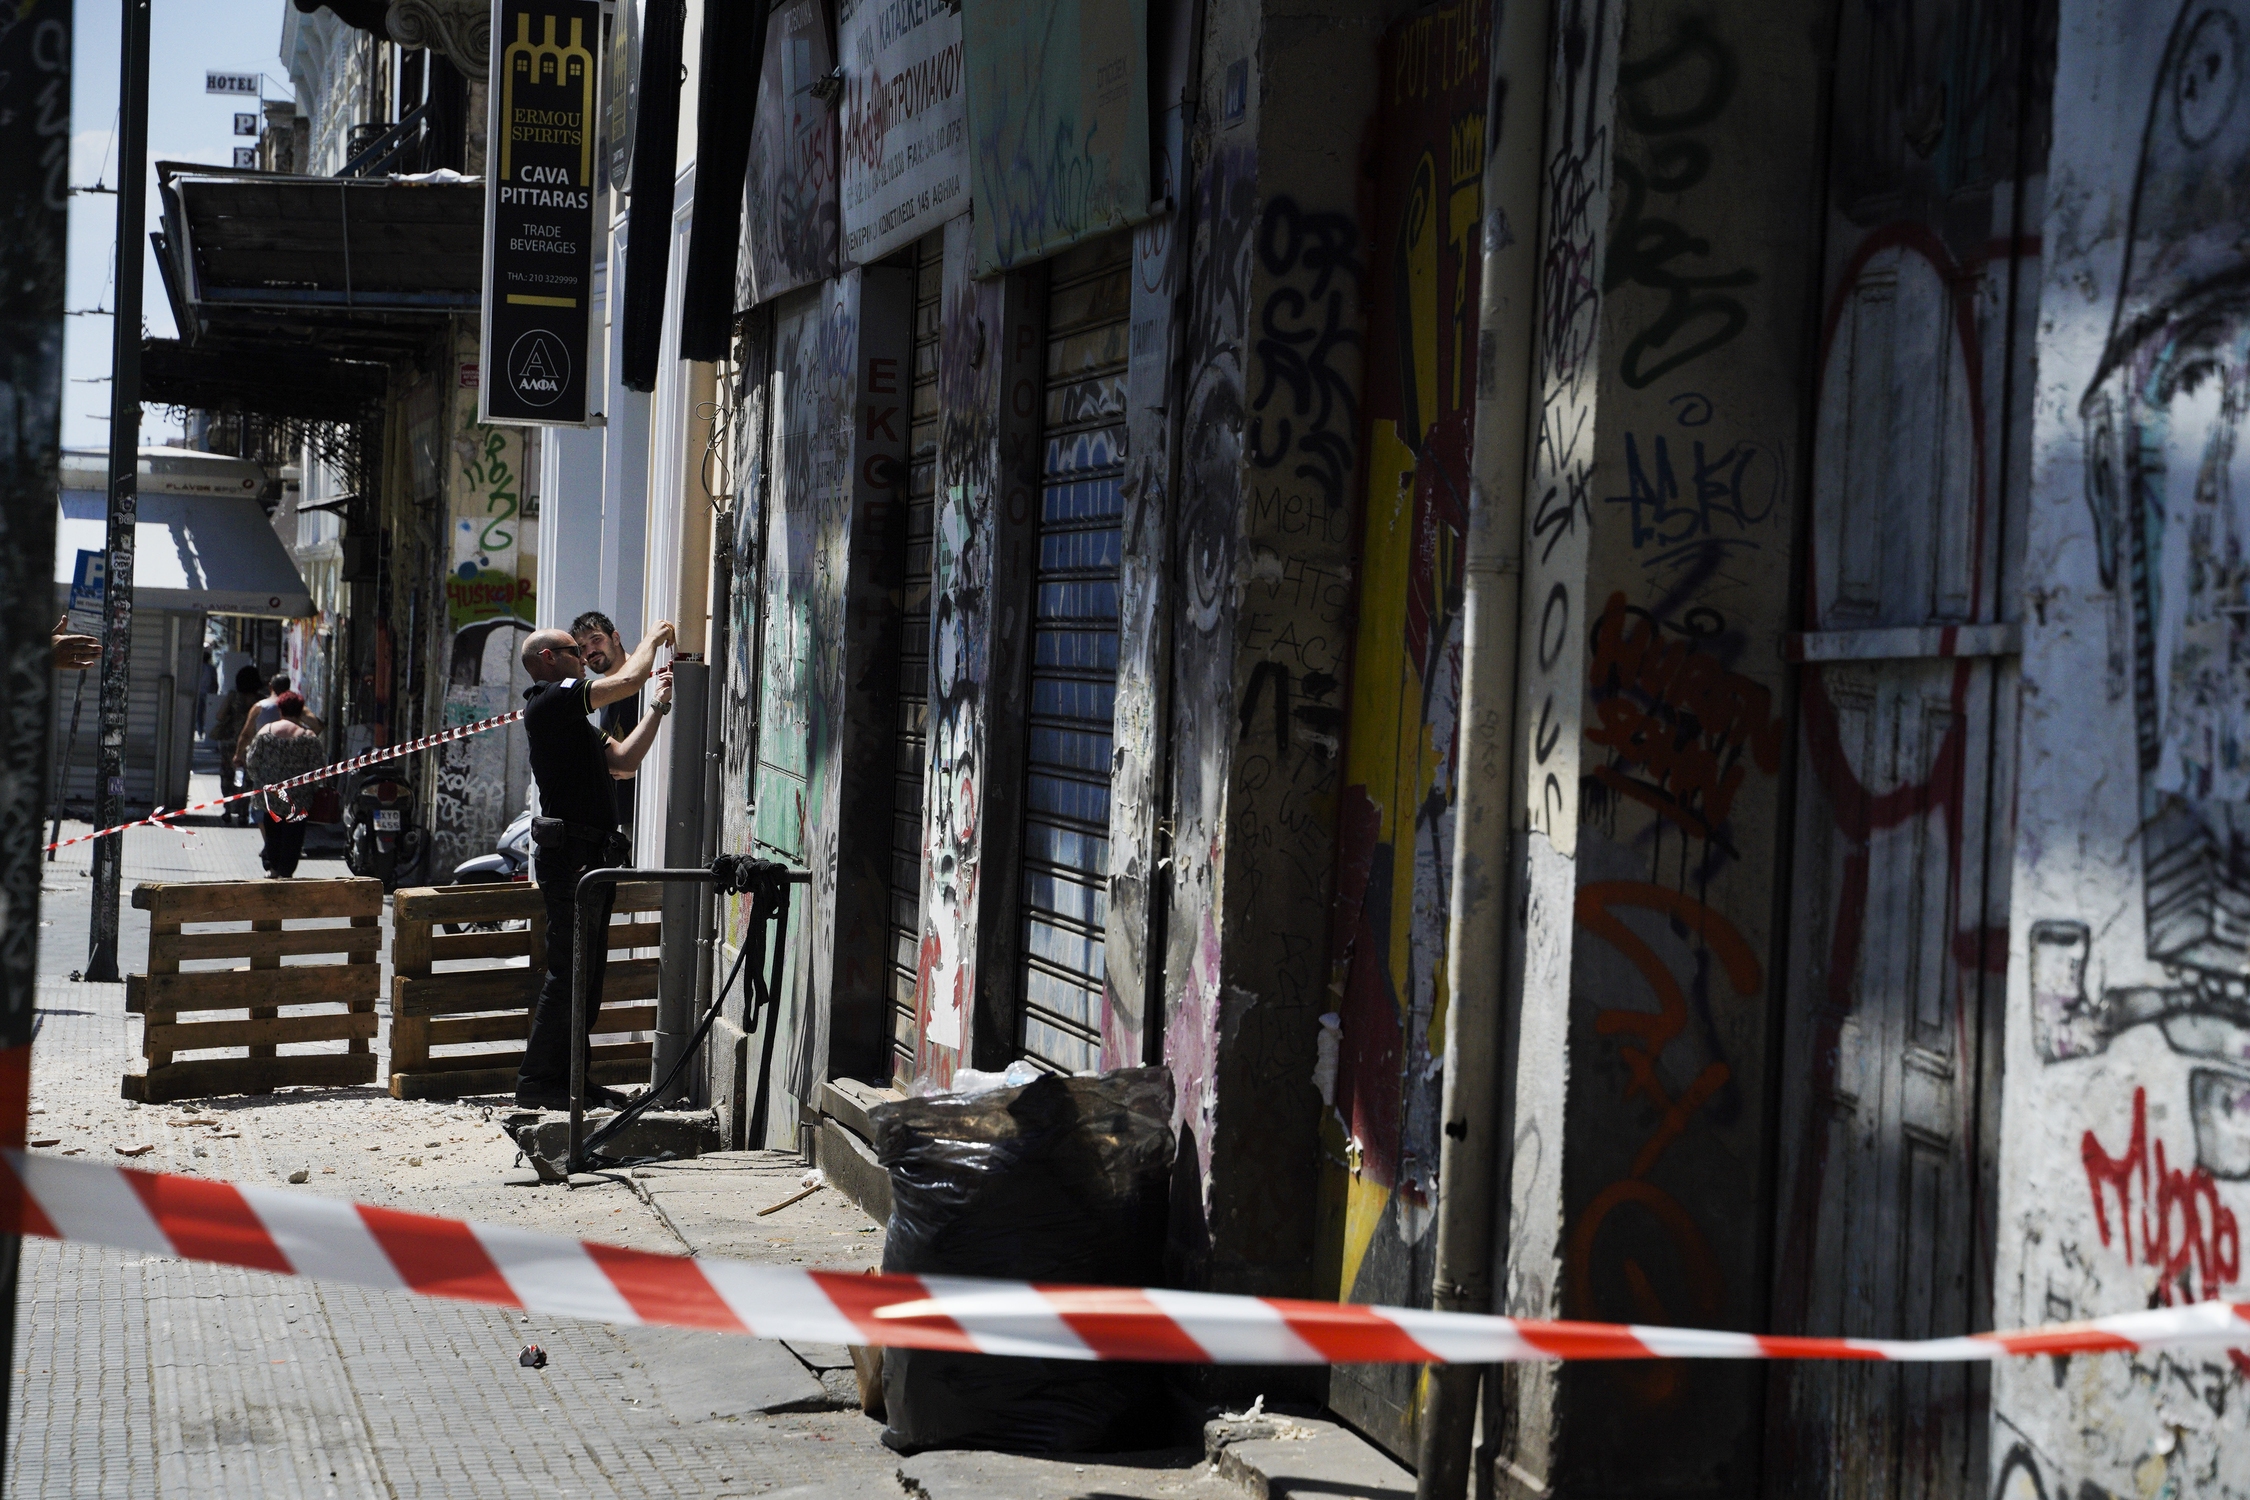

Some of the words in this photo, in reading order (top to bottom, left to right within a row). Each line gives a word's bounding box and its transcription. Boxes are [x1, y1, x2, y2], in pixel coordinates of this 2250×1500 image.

[206, 74, 256, 92] HOTEL
[514, 108, 581, 128] ERMOU
[512, 126, 582, 146] SPIRITS
[520, 165, 570, 185] CAVA
[500, 187, 589, 210] PITTARAS
[932, 173, 961, 207] ΑΘΗΝΑ
[522, 223, 562, 239] TRADE
[510, 238, 577, 255] BEVERAGES
[528, 273, 544, 284] 210
[544, 274, 579, 286] 3229999
[518, 377, 559, 392] ΑΛΦΑ
[166, 483, 211, 492] FLAVOR
[214, 485, 243, 493] SPOT
[192, 602, 238, 611] FLAVOR
